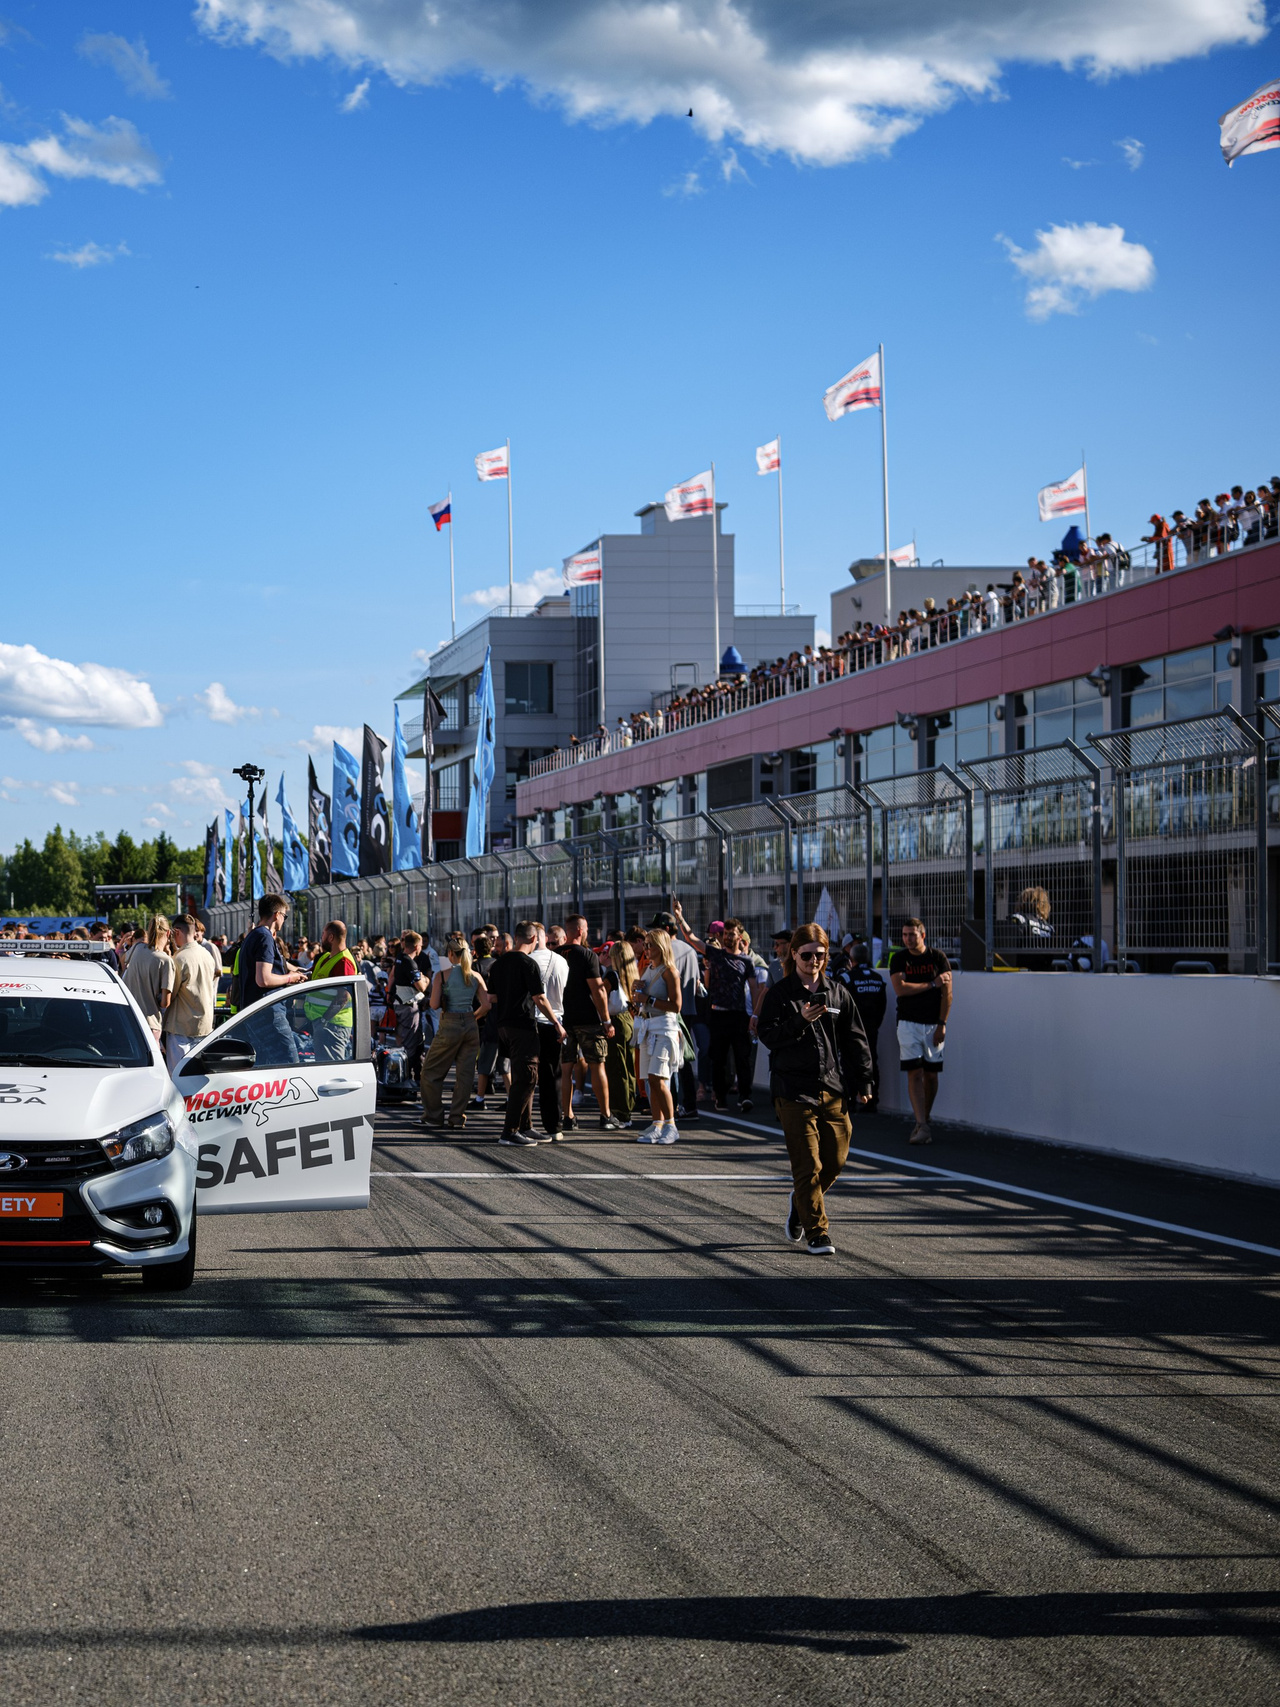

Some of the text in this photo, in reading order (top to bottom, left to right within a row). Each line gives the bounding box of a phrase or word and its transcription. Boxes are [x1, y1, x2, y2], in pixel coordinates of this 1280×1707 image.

[62, 986, 107, 995] VESTA
[857, 985, 881, 993] CREW
[185, 1079, 288, 1112] MOSCOW
[188, 1103, 253, 1124] ACEWAY
[196, 1114, 375, 1189] SAFET
